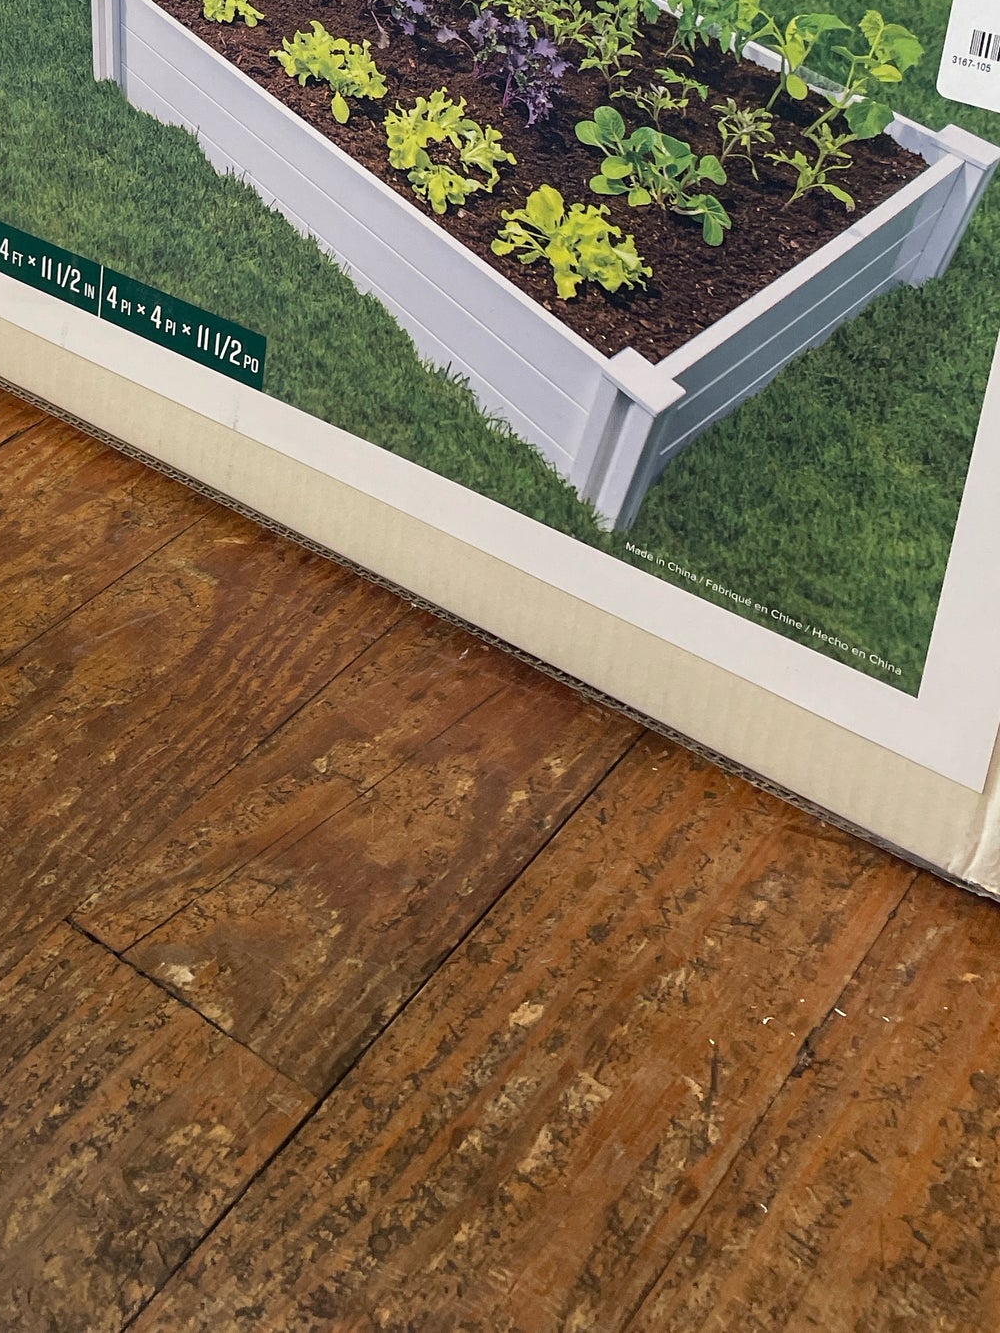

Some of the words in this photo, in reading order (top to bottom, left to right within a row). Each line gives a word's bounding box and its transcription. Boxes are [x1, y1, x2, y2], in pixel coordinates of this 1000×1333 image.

[952, 55, 991, 73] 3167-105
[0, 238, 9, 261] 4
[12, 251, 24, 267] FT
[57, 262, 81, 293] 1/2
[84, 282, 95, 300] IN
[106, 285, 117, 309] 4
[121, 299, 132, 316] PI
[150, 305, 162, 329] 4
[165, 319, 177, 336] PI
[214, 332, 241, 366] 1/2
[243, 354, 259, 374] PO
[625, 541, 654, 563] Made
[656, 555, 665, 567] in
[667, 561, 697, 582] China
[705, 578, 752, 607] Fabriqué
[754, 603, 769, 615] en
[770, 609, 803, 630] Chine
[812, 627, 849, 652] Hecho
[851, 646, 866, 659] en
[868, 654, 902, 676] China
